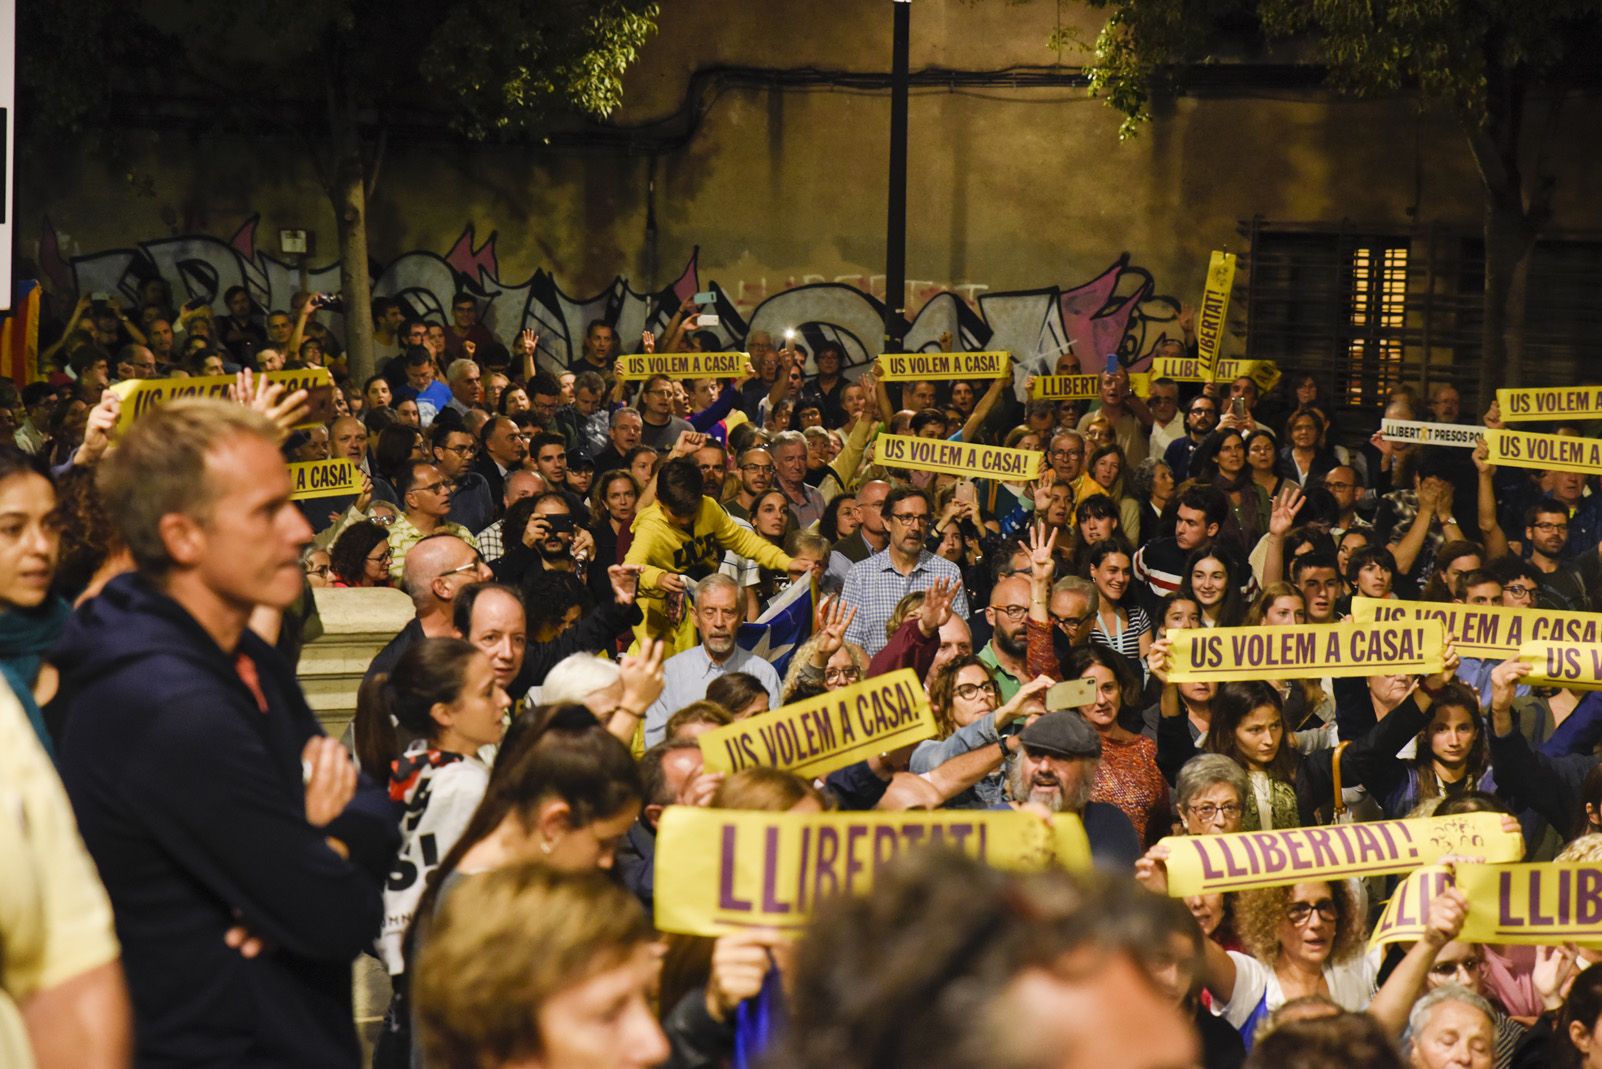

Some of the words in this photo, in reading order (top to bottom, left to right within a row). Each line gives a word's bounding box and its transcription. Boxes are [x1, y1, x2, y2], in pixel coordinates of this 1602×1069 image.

[1200, 290, 1225, 370] LLIBERTAT!
[629, 358, 644, 374] US
[648, 357, 689, 373] VOLEM
[692, 356, 701, 372] A
[704, 356, 740, 371] CASA!
[890, 358, 906, 374] US
[908, 357, 950, 373] VOLEM
[954, 356, 962, 372] A
[965, 355, 1000, 372] CASA!
[1164, 360, 1239, 378] LLIBEAT!
[1042, 376, 1100, 396] LLIBERT
[1510, 393, 1530, 412] US
[1536, 391, 1590, 412] VOLEM
[1434, 428, 1468, 442] PRESOS
[1500, 435, 1521, 458] US
[1526, 438, 1584, 464] VOLEM
[1590, 444, 1600, 465] A
[884, 438, 905, 459] US
[910, 442, 962, 467] VOLEM
[966, 448, 976, 468] A
[982, 450, 1028, 474] CASA!
[296, 468, 306, 490] A
[311, 463, 352, 488] CASA!
[1506, 615, 1522, 646] A
[1532, 616, 1602, 642] CASA
[1190, 635, 1224, 669] US
[1232, 632, 1316, 666] VOLEM
[1324, 630, 1342, 664] A
[1350, 628, 1424, 662] CASA!
[1546, 647, 1581, 680] US
[724, 732, 759, 774] US
[759, 706, 837, 768] VOLEM
[838, 700, 856, 745] A
[857, 680, 920, 738] CASA!
[1192, 817, 1420, 880] LLIBERTAT!
[718, 824, 986, 914] LLIBE
[1499, 868, 1602, 926] LLIB
